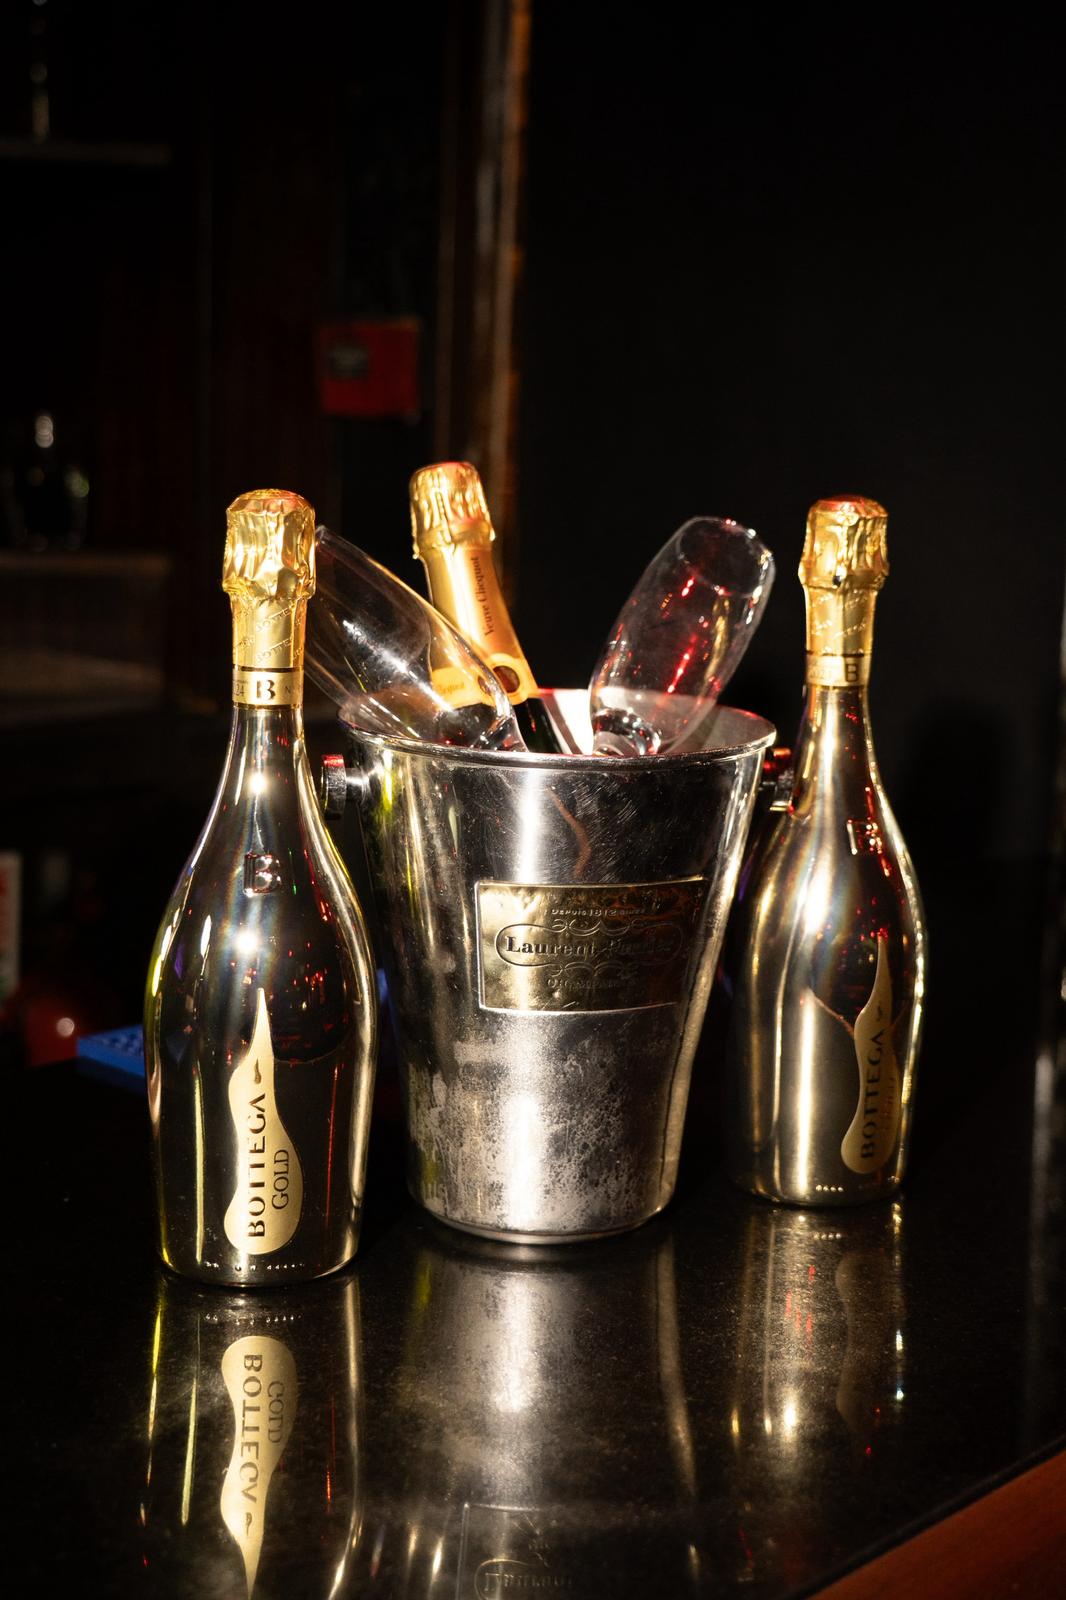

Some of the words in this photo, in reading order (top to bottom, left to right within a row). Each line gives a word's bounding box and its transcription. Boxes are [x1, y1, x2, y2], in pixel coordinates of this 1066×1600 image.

[256, 679, 276, 700] B
[845, 664, 859, 682] B
[243, 852, 281, 898] B
[861, 1029, 885, 1159] BOTTEGA
[247, 1092, 266, 1238] BOTTEGA
[272, 1149, 289, 1210] GOLD
